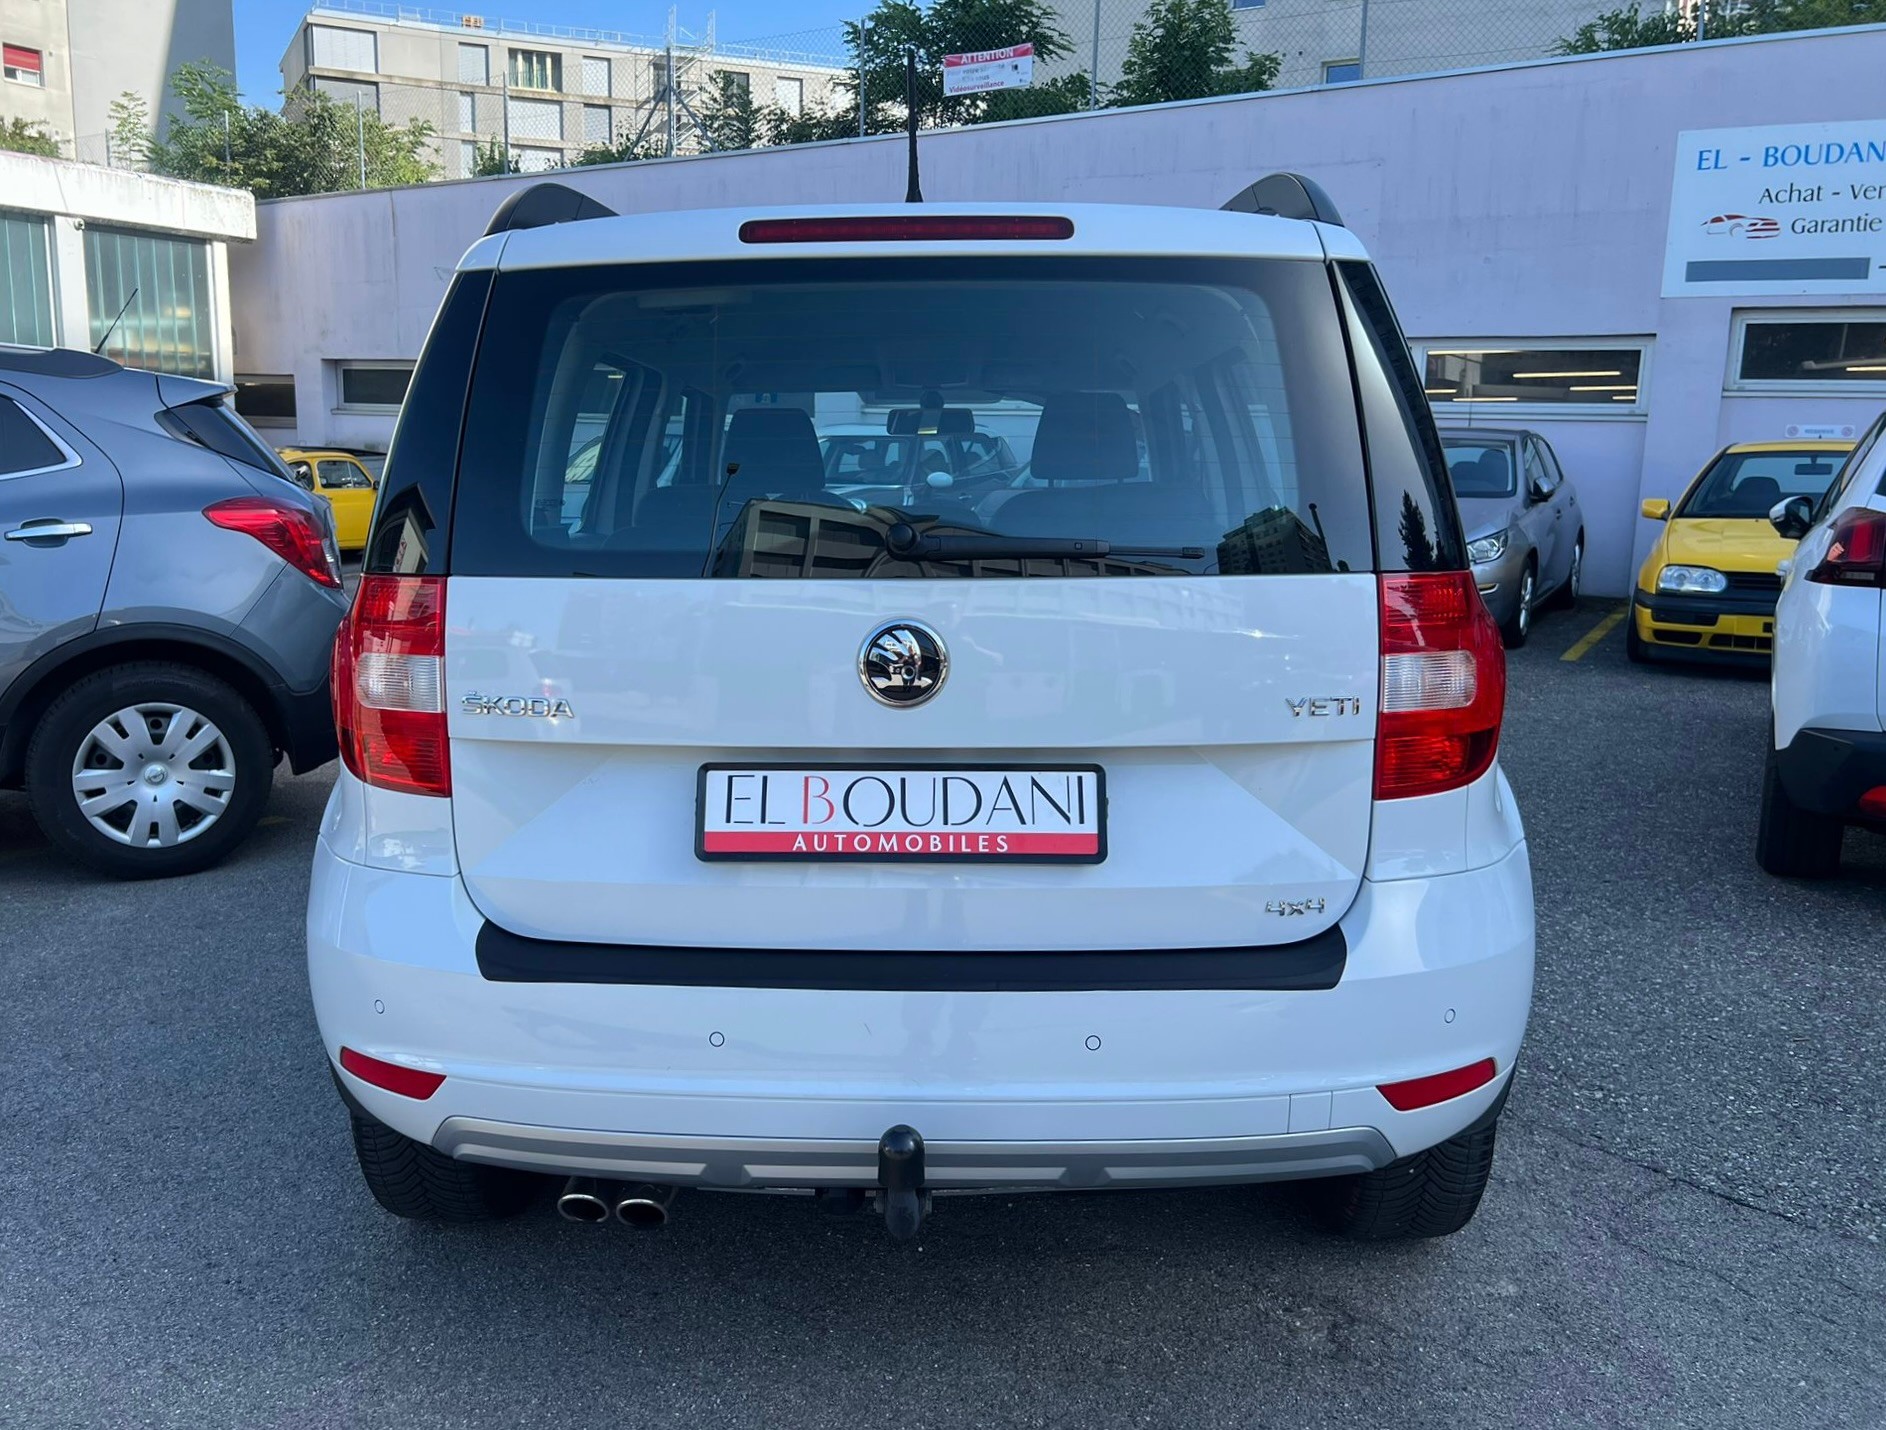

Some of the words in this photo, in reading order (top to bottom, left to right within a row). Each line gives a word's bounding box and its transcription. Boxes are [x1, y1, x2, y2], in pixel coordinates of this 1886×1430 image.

[960, 47, 1014, 64] ATTENTION
[1696, 149, 1728, 171] EL
[1762, 140, 1886, 168] BOUDAN
[1758, 182, 1824, 205] Achat
[1850, 183, 1886, 201] Ver
[1790, 212, 1883, 235] Garantie
[461, 691, 575, 718] ŠKODA
[1285, 696, 1360, 717] YETI
[725, 774, 786, 825] EL
[802, 774, 1086, 828] BOUDANI
[791, 833, 1009, 852] AUTOMOBILES
